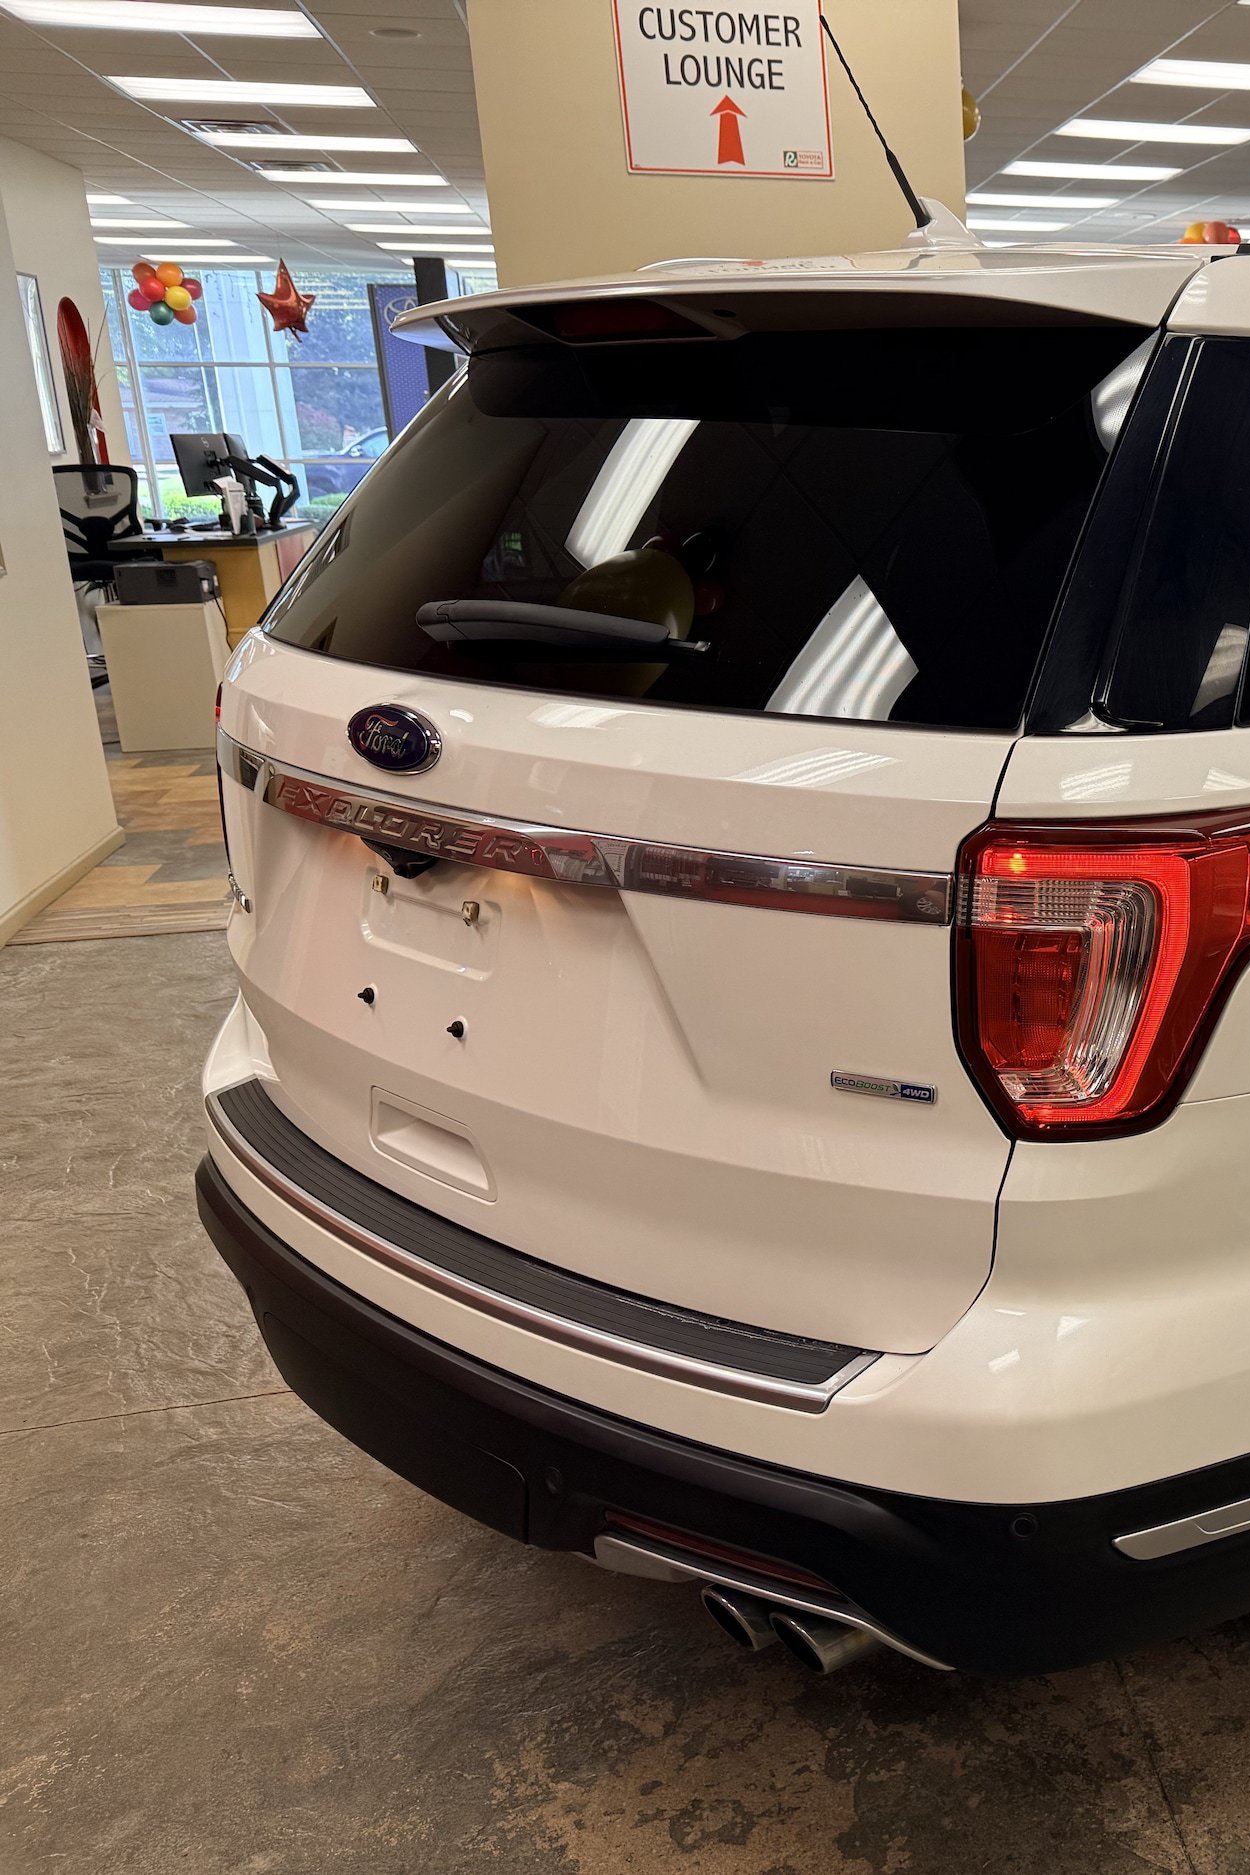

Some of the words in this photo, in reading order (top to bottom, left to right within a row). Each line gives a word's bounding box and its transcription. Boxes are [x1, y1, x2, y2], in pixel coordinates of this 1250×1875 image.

[638, 7, 802, 48] CUSTOMER
[663, 53, 785, 90] LOUNGE
[359, 713, 409, 759] Ford
[277, 781, 526, 863] EXPLORER
[902, 1088, 930, 1099] 4WD
